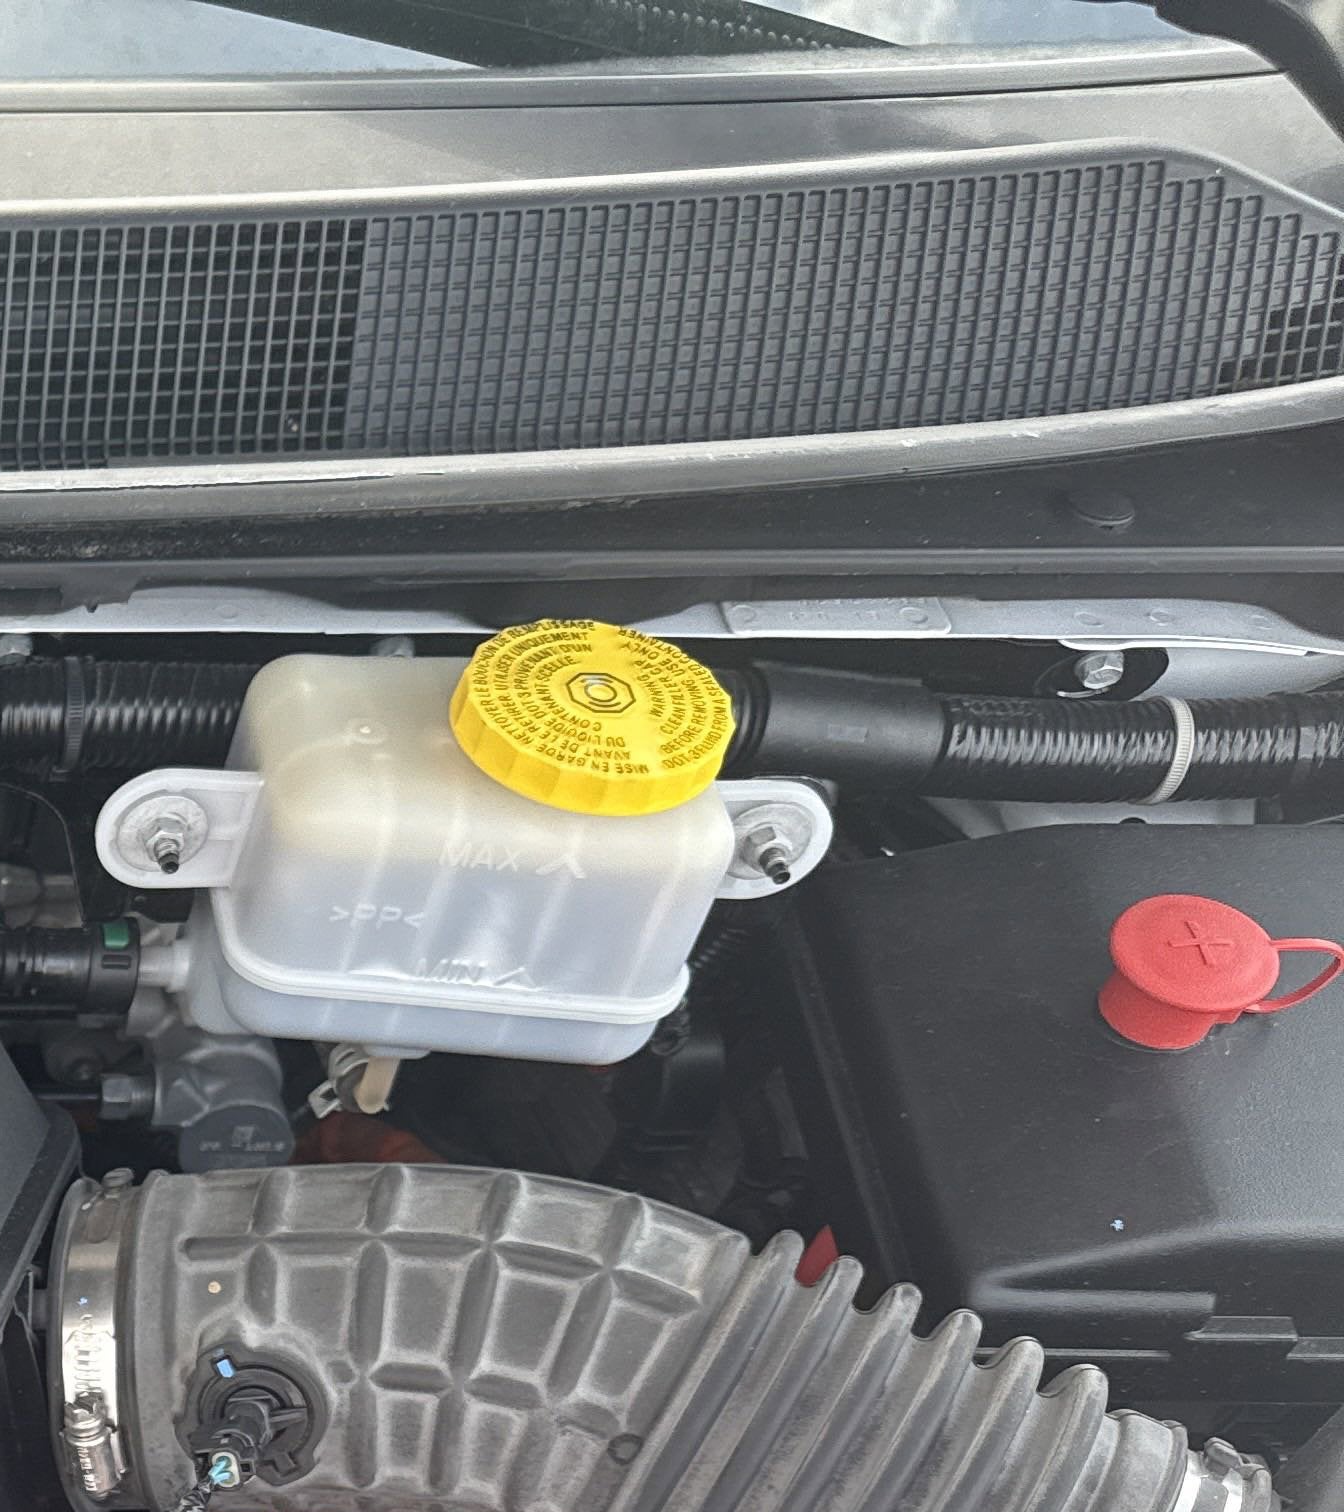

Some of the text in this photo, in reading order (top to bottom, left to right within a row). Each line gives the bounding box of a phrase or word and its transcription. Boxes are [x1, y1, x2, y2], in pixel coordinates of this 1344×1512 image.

[490, 633, 513, 648] DE
[507, 631, 589, 657] UNIQUEMENT
[619, 638, 662, 661] ONLY
[471, 643, 501, 685] BOUCHON
[511, 645, 561, 690] PROVENANT
[657, 657, 687, 677] USE
[472, 686, 491, 697] LE
[655, 674, 687, 706] FILLER
[685, 662, 724, 696] SEALED
[532, 681, 601, 736] CONTENANT
[633, 672, 668, 719] WARNING
[476, 698, 535, 746] NETTOYER
[520, 699, 550, 719] DOT
[657, 705, 687, 736] CLEAN
[709, 705, 728, 732] FROM
[536, 730, 559, 744] LE
[557, 739, 580, 753] DE
[605, 735, 627, 747] DU
[657, 724, 703, 755] BEFORE
[532, 742, 586, 768] GARDE
[582, 745, 633, 761] AVANT
[590, 759, 609, 772] EN
[659, 752, 694, 769] DOT
[614, 762, 651, 774] MISE
[440, 842, 520, 873] MAX
